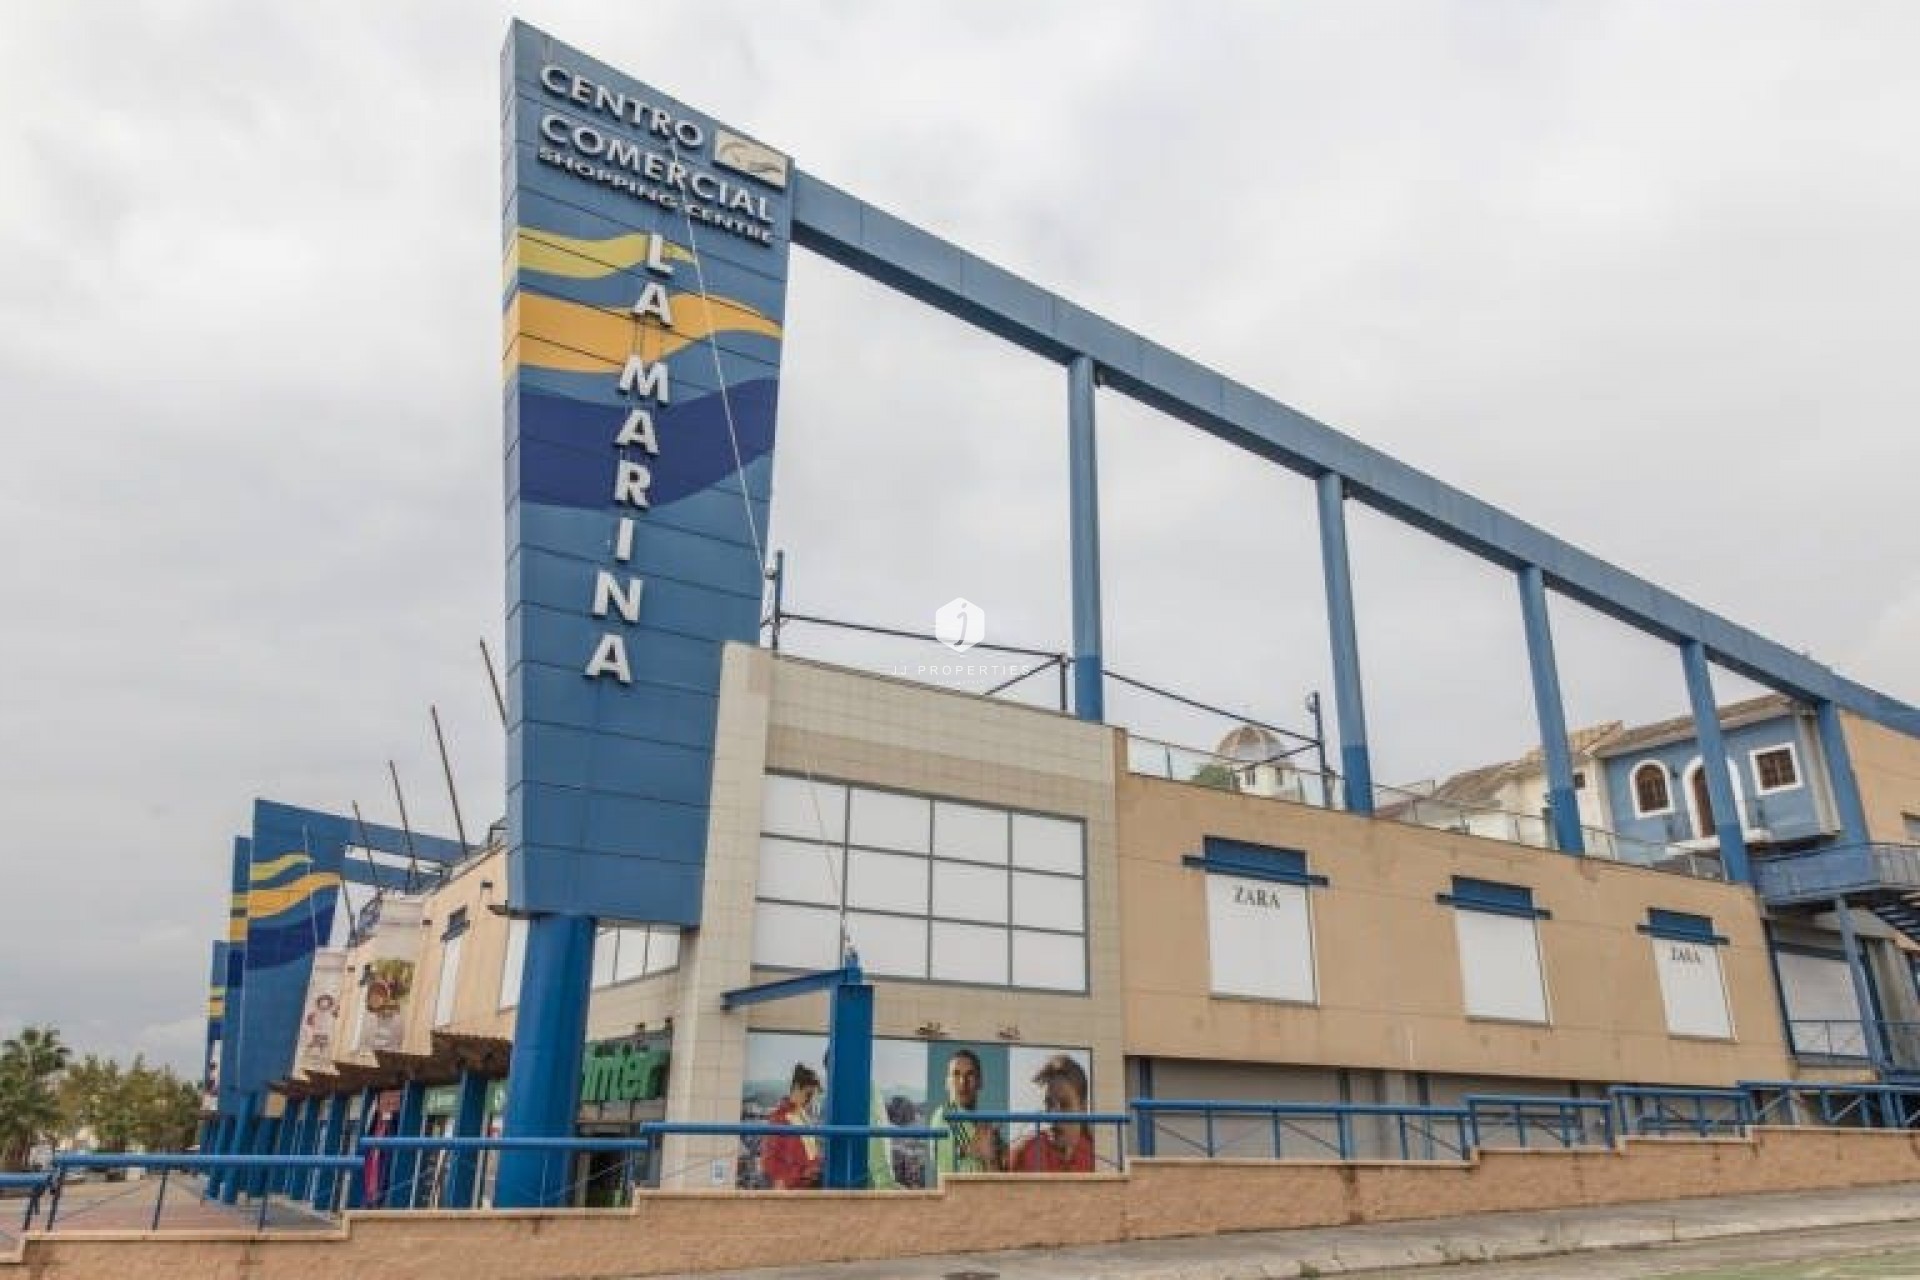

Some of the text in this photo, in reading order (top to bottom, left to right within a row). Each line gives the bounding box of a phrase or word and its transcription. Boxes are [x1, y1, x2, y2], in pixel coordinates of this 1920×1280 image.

[540, 65, 703, 147] CENTRO
[537, 146, 775, 243] SHOPPING CENTRE
[541, 114, 774, 223] COMERCIAL
[584, 234, 674, 683] LA MARINA
[1232, 884, 1281, 910] ZARA
